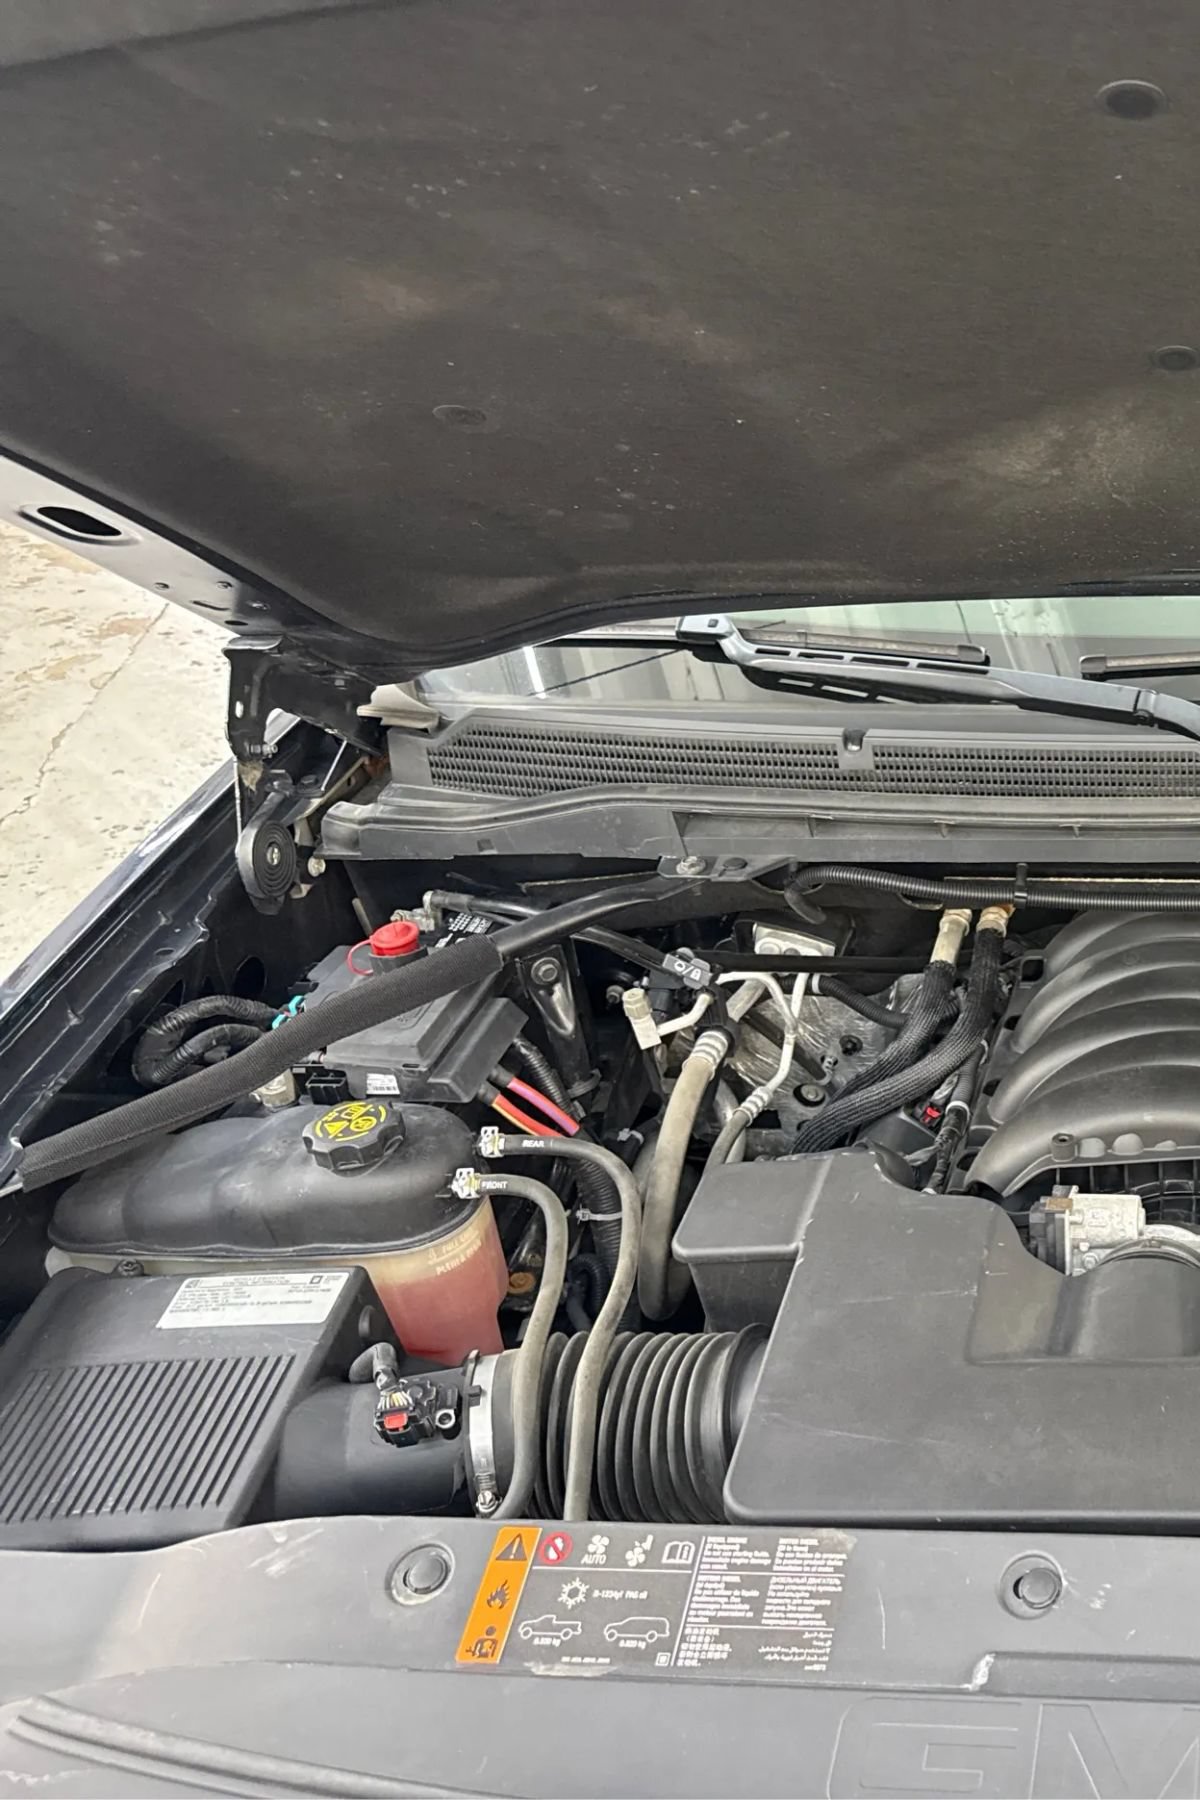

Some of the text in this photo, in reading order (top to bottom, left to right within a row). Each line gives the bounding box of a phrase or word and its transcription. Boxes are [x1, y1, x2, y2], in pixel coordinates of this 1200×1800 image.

[522, 1140, 545, 1148] REAR
[482, 1181, 508, 1190] FRONT
[581, 1554, 607, 1565] AUTO
